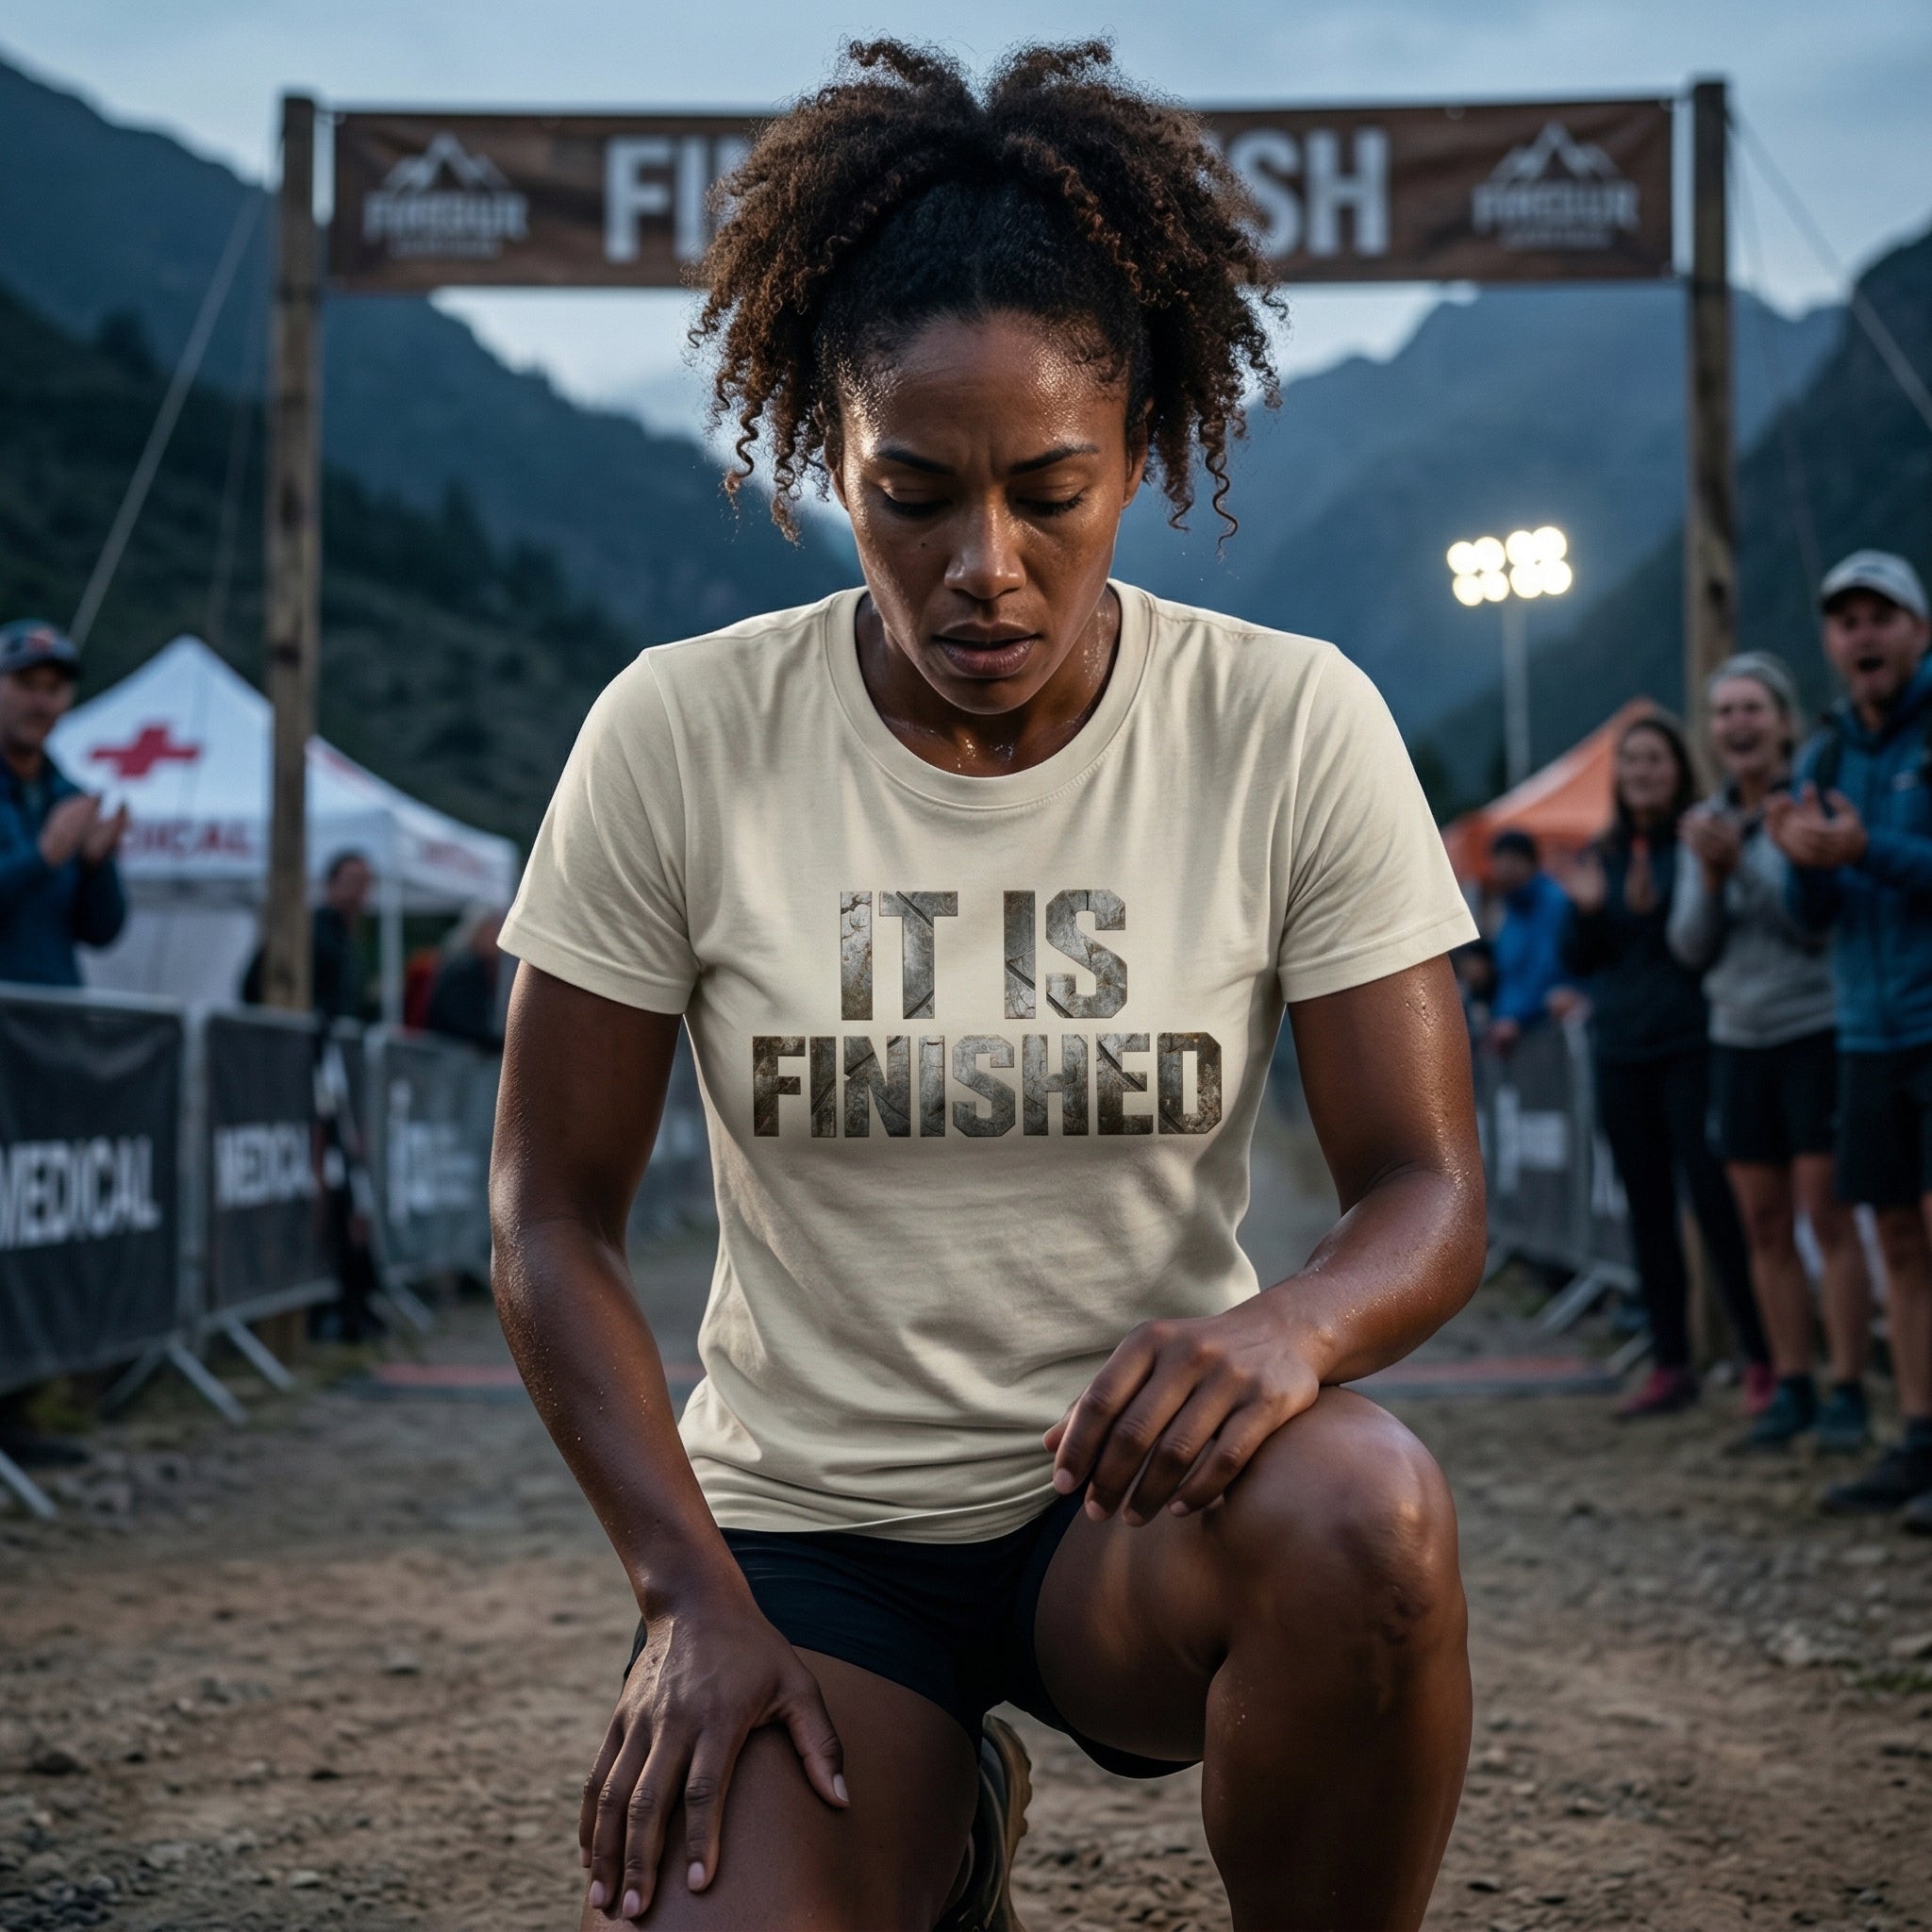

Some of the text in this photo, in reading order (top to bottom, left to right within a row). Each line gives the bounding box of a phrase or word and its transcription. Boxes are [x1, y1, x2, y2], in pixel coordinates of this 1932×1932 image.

[1199, 128, 1388, 258] SH
[840, 889, 1128, 1021] IT IS
[752, 1031, 1224, 1138] FINISHED
